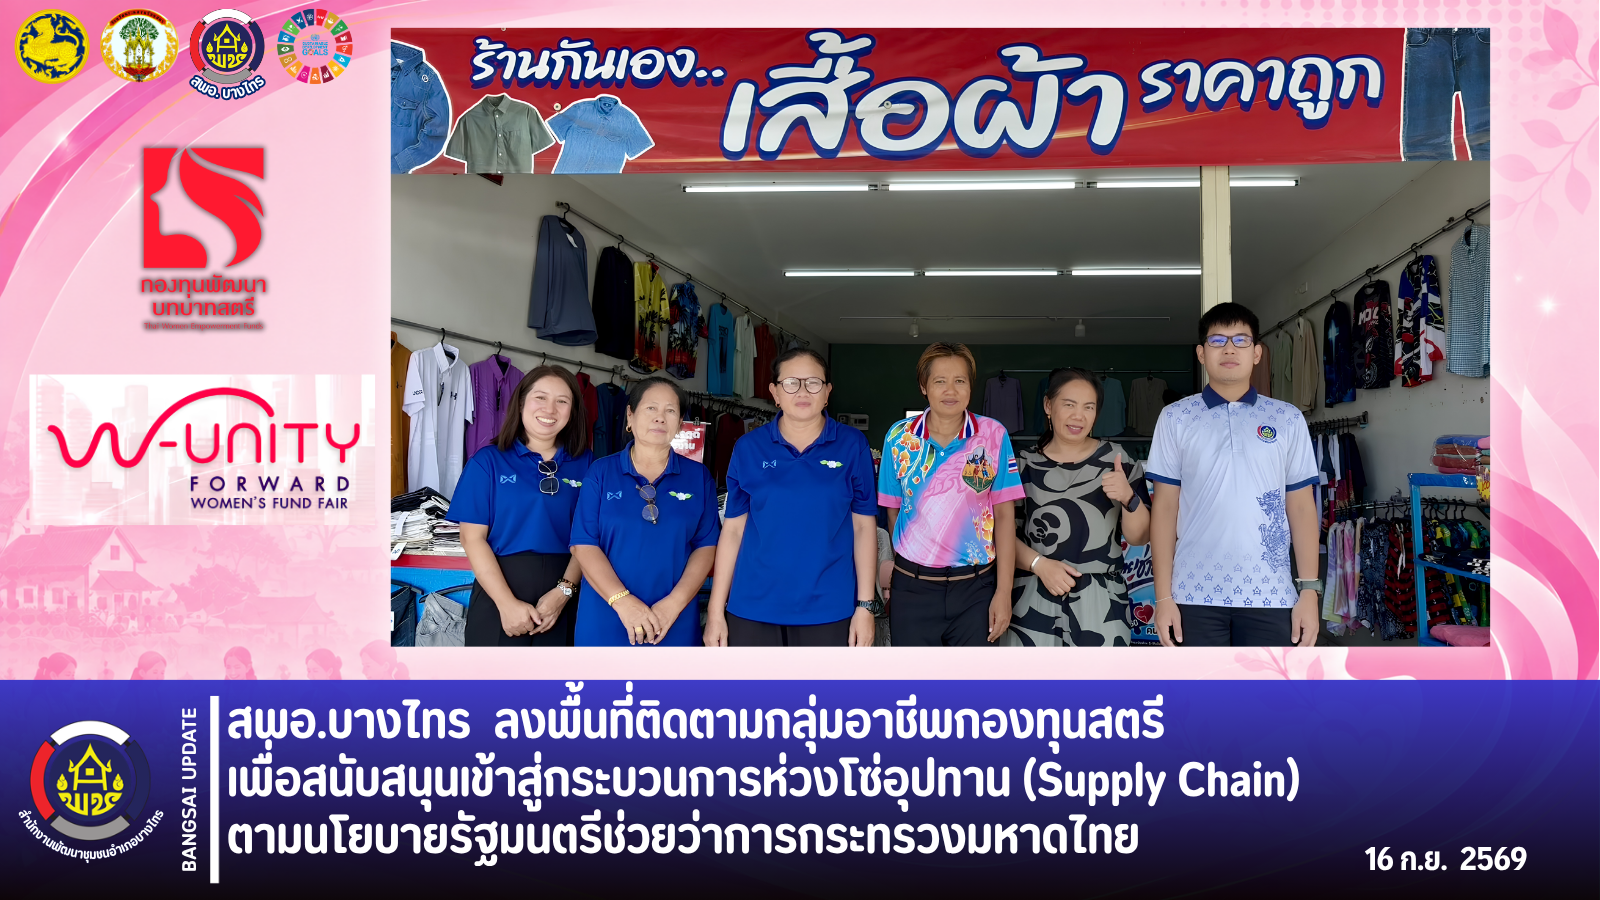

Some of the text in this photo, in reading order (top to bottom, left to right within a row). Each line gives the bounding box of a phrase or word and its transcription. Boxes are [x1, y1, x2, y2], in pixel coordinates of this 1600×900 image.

[472, 37, 726, 84] ร้านกันเอง..
[721, 31, 1125, 155] เสื้อผ้า
[1140, 56, 1382, 121] ราคาถูก
